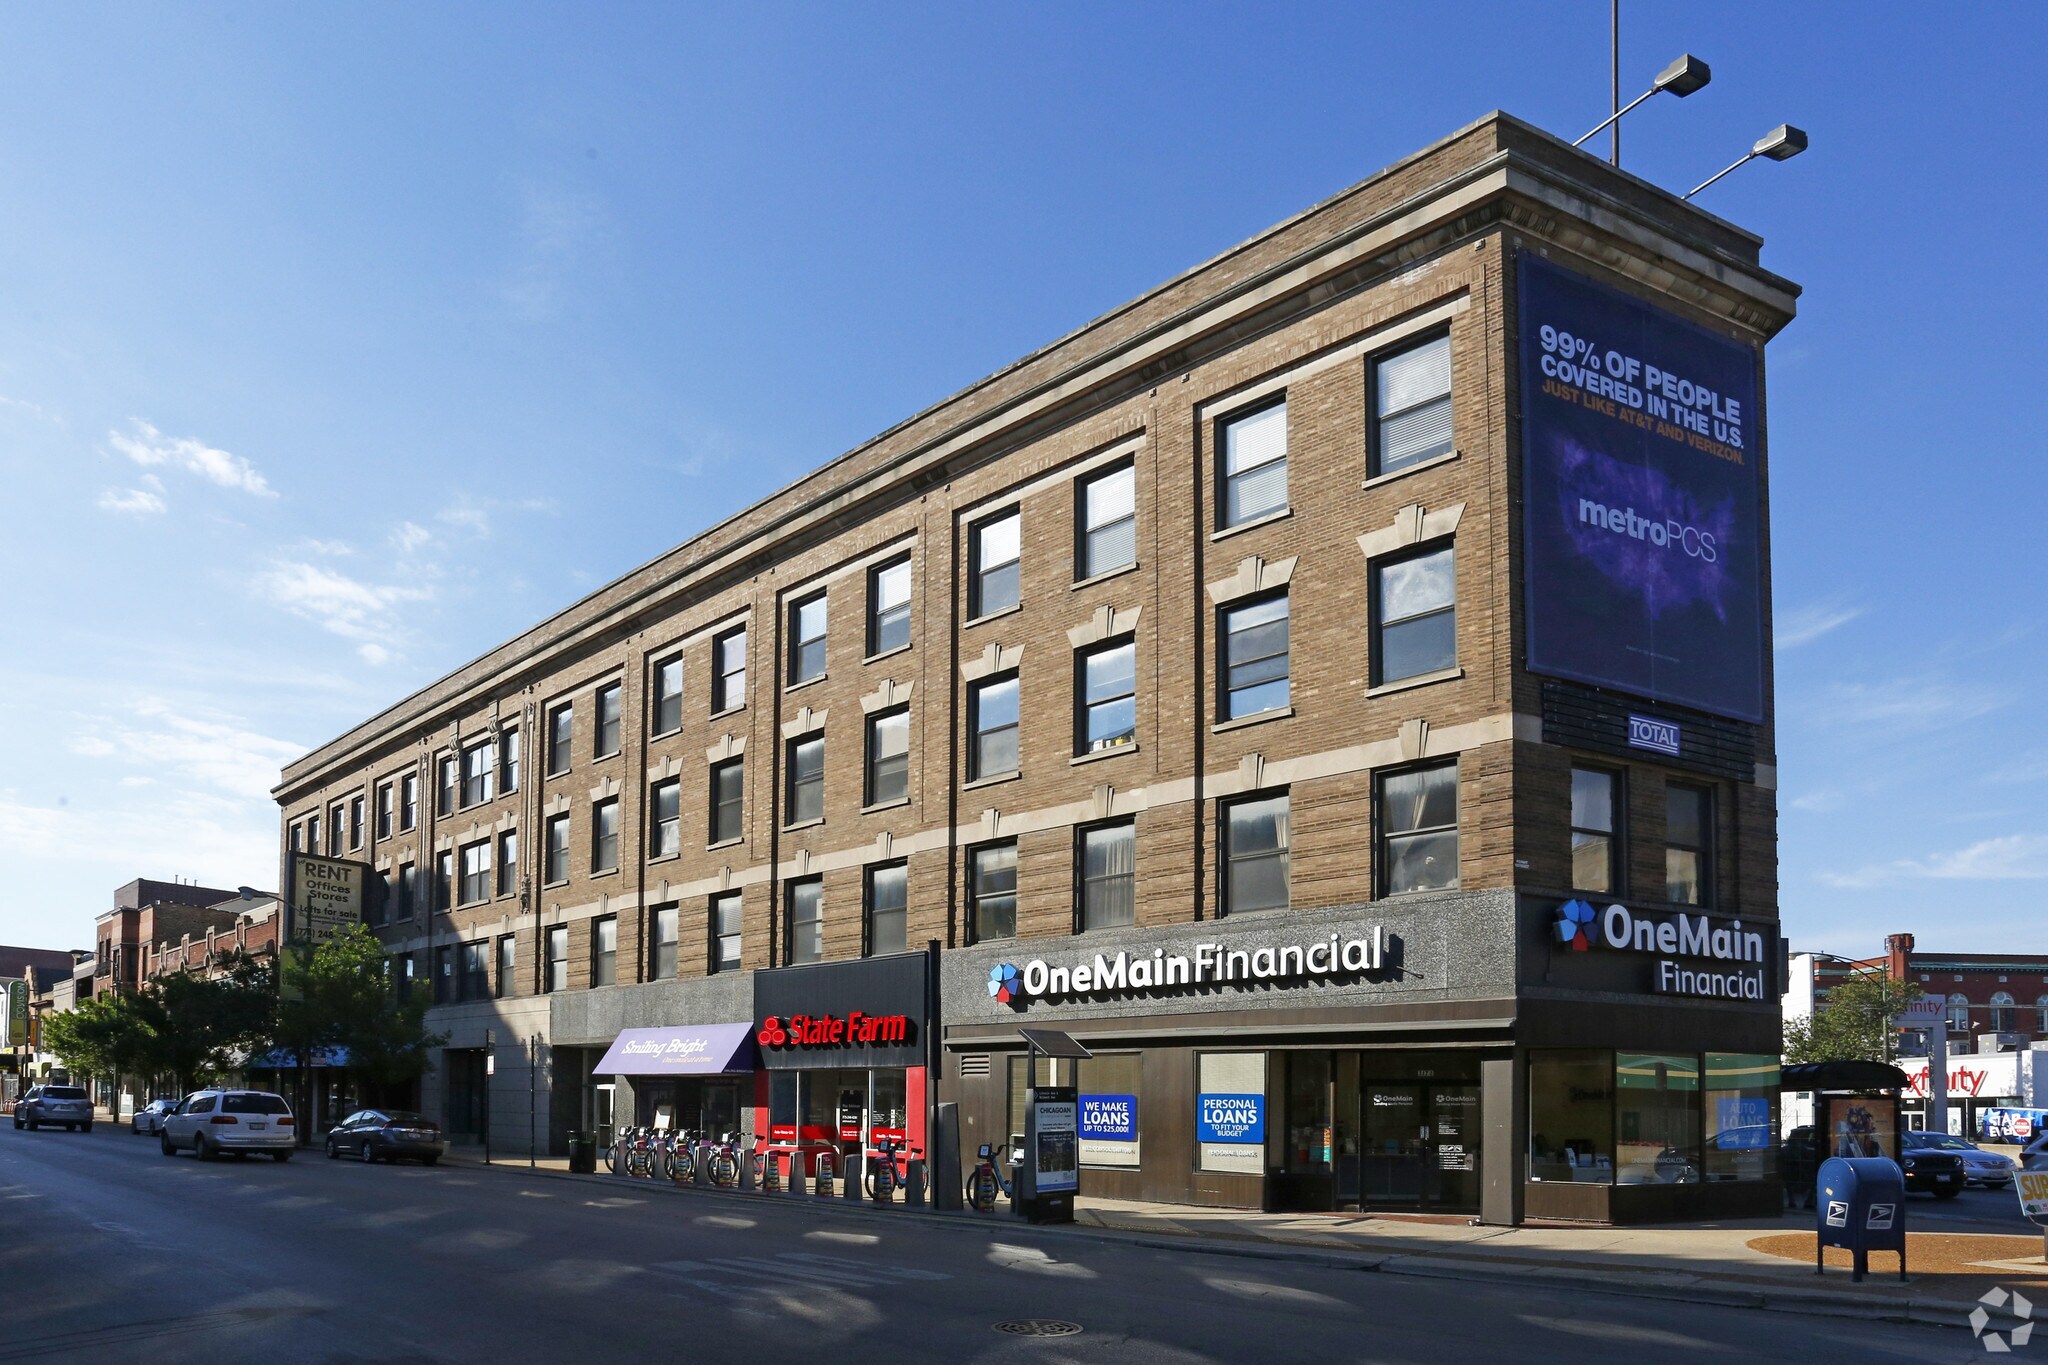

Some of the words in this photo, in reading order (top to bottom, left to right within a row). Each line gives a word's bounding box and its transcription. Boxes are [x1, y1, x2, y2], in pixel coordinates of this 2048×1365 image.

[1540, 325, 1600, 369] 99%
[1605, 351, 1640, 382] OF
[1646, 364, 1741, 425] PEOPLE
[1541, 354, 1643, 409] COVERED
[1647, 394, 1667, 419] IN
[1671, 402, 1709, 436] THE
[1714, 420, 1744, 449] U.S.
[1542, 379, 1579, 404] JUST
[1583, 393, 1615, 417] LIKE
[1619, 405, 1654, 431] AT&T
[1656, 422, 1684, 442] AND
[1687, 431, 1744, 465] VERIZON.
[1630, 720, 1678, 747] TOTAL
[305, 862, 352, 882] RENT
[306, 880, 351, 894] Offices
[309, 889, 349, 903] Stores
[324, 907, 337, 917] for
[339, 909, 358, 919] sale
[1604, 904, 1763, 962] OneMain
[1661, 960, 1764, 999] Financial
[791, 1013, 843, 1044] State
[847, 1012, 906, 1042] Farm
[621, 1040, 667, 1058] Smiling
[665, 1039, 708, 1057] Bright
[1085, 1102, 1100, 1111] WE
[1102, 1102, 1128, 1111] MAKE
[1204, 1099, 1257, 1109] PERSONAL
[1729, 1103, 1756, 1114] AUTO
[1084, 1112, 1129, 1125] LOANS
[1204, 1109, 1257, 1124] LOANS
[1723, 1115, 1764, 1130] LOANS
